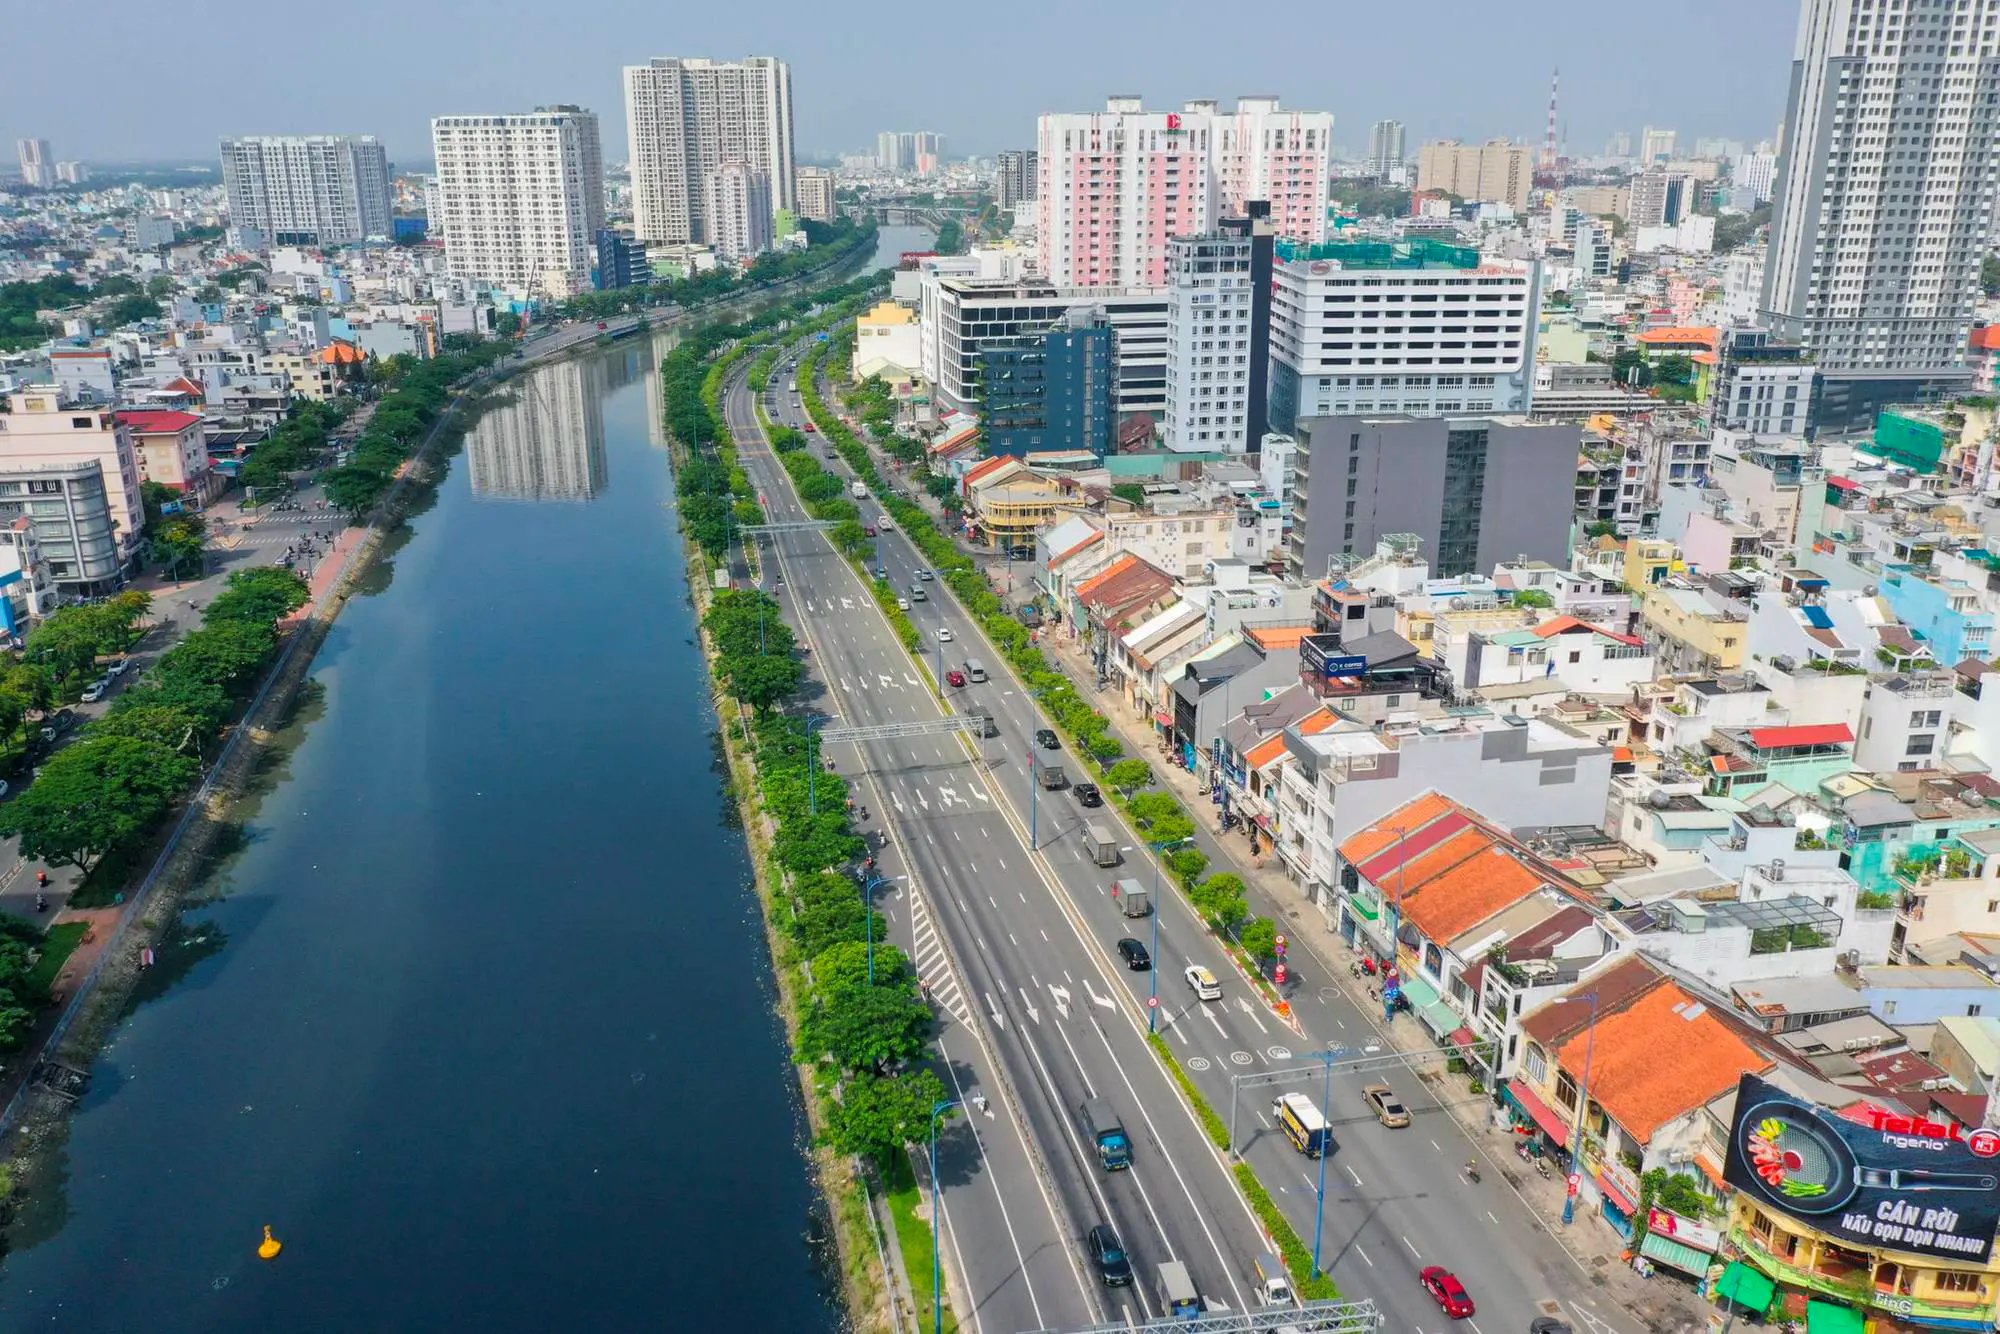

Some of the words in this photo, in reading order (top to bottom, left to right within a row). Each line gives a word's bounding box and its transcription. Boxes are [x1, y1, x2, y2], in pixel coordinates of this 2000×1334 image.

[1868, 1110, 1967, 1142] Tefal
[1877, 1200, 1920, 1225] CÁN
[1921, 1207, 1959, 1232] RỜI
[1841, 1213, 1872, 1234] NẤU
[1873, 1222, 1903, 1242] GỌN
[1904, 1228, 1934, 1247] DỌN
[1934, 1233, 1986, 1254] NHANH
